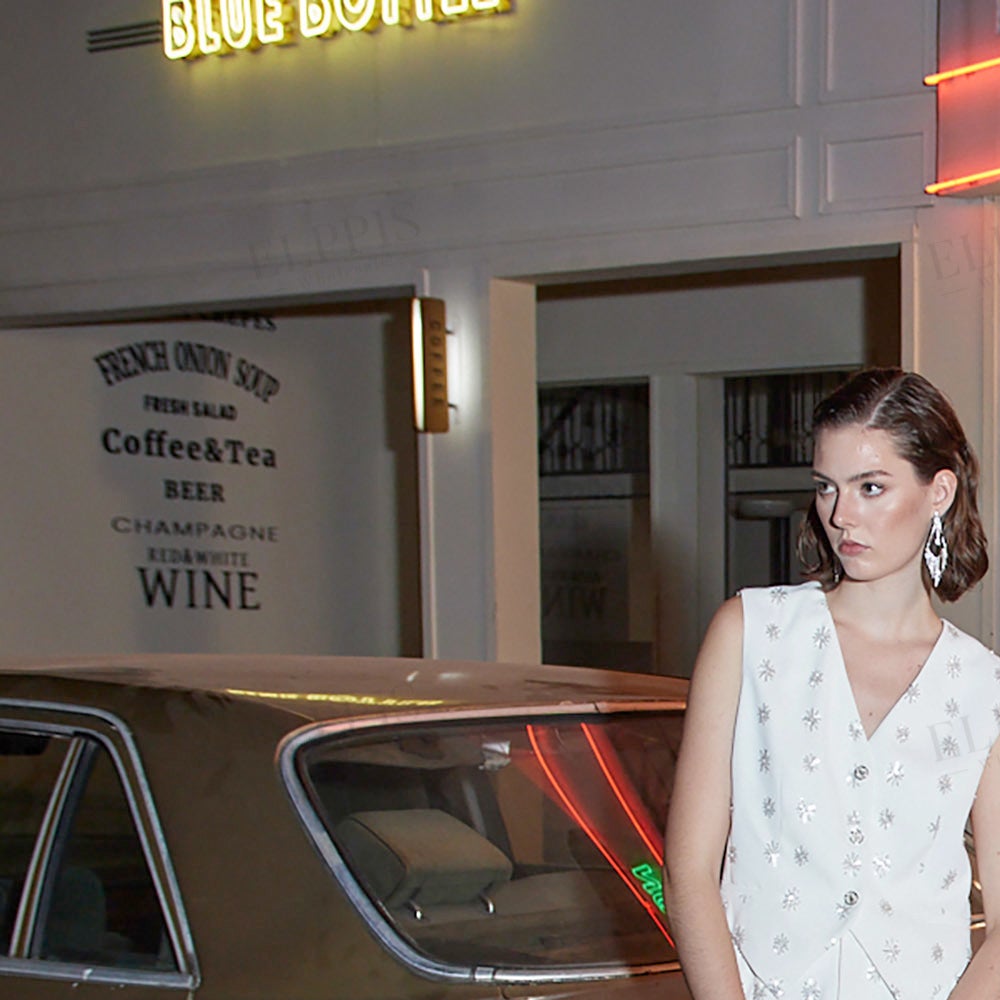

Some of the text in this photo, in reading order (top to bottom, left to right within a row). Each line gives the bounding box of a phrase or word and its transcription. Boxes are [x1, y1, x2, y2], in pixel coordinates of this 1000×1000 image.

[163, 0, 282, 59] BLUE
[94, 340, 171, 387] FRENCH
[102, 428, 278, 468] Coffee&Tea
[164, 478, 226, 503] BEER
[111, 516, 279, 543] CHAMPAGNE
[139, 566, 261, 610] WINE
